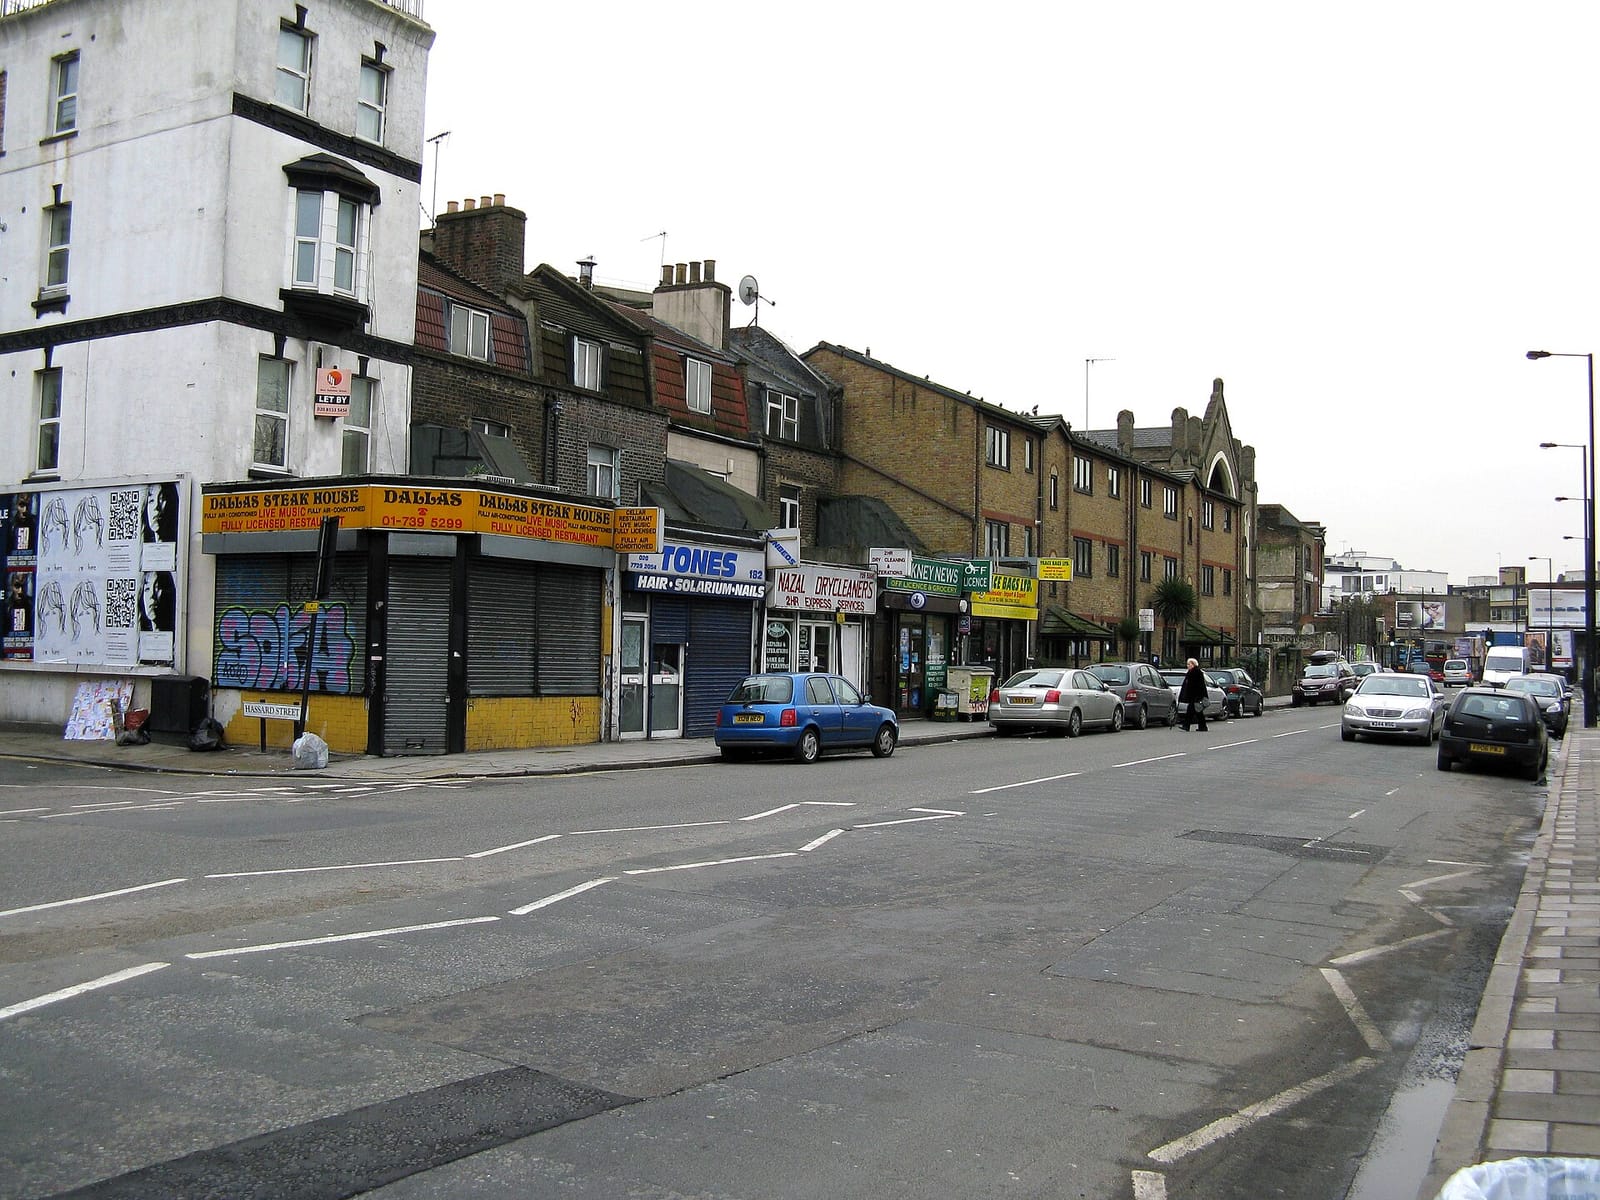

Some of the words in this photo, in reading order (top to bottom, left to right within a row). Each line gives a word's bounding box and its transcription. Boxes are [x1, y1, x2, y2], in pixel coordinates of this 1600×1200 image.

[210, 495, 259, 510] DALLAS
[264, 492, 309, 506] STEAK
[314, 490, 359, 504] HOUSE
[384, 490, 462, 506] DALLAS
[258, 509, 276, 518] LIVE
[279, 506, 306, 517] MUSIC
[480, 494, 528, 514] DALLAS
[531, 502, 570, 518] STEAK
[574, 508, 610, 525] HOUSE
[222, 520, 242, 530] FULLY
[246, 518, 286, 528] LICENSED
[290, 516, 344, 527] RESTAUT
[382, 516, 424, 527] 01-739
[431, 518, 462, 528] 5299
[526, 516, 542, 526] LIVE
[545, 518, 568, 529] MUSIC
[492, 522, 512, 532] FULLY
[516, 526, 552, 538] LICENSED
[555, 530, 599, 544] RESTAURANT
[661, 545, 738, 578] TONES
[912, 562, 934, 581] KNEY
[934, 567, 959, 584] NEWS
[964, 566, 987, 574] OFF
[638, 575, 668, 590] HAIR
[674, 578, 732, 596] SOLARIUM
[734, 584, 765, 598] NAILS
[778, 572, 806, 594] NAZAL
[815, 576, 874, 599] DRYCLEANERS
[904, 581, 928, 590] LICENCE
[964, 577, 988, 588] LICENCE
[1002, 576, 1020, 590] BAGS
[786, 596, 799, 606] 2HR
[804, 596, 832, 609] EXPRESS
[838, 600, 865, 611] SERVICES
[245, 704, 274, 714] HASSARD
[276, 708, 300, 716] STREET
